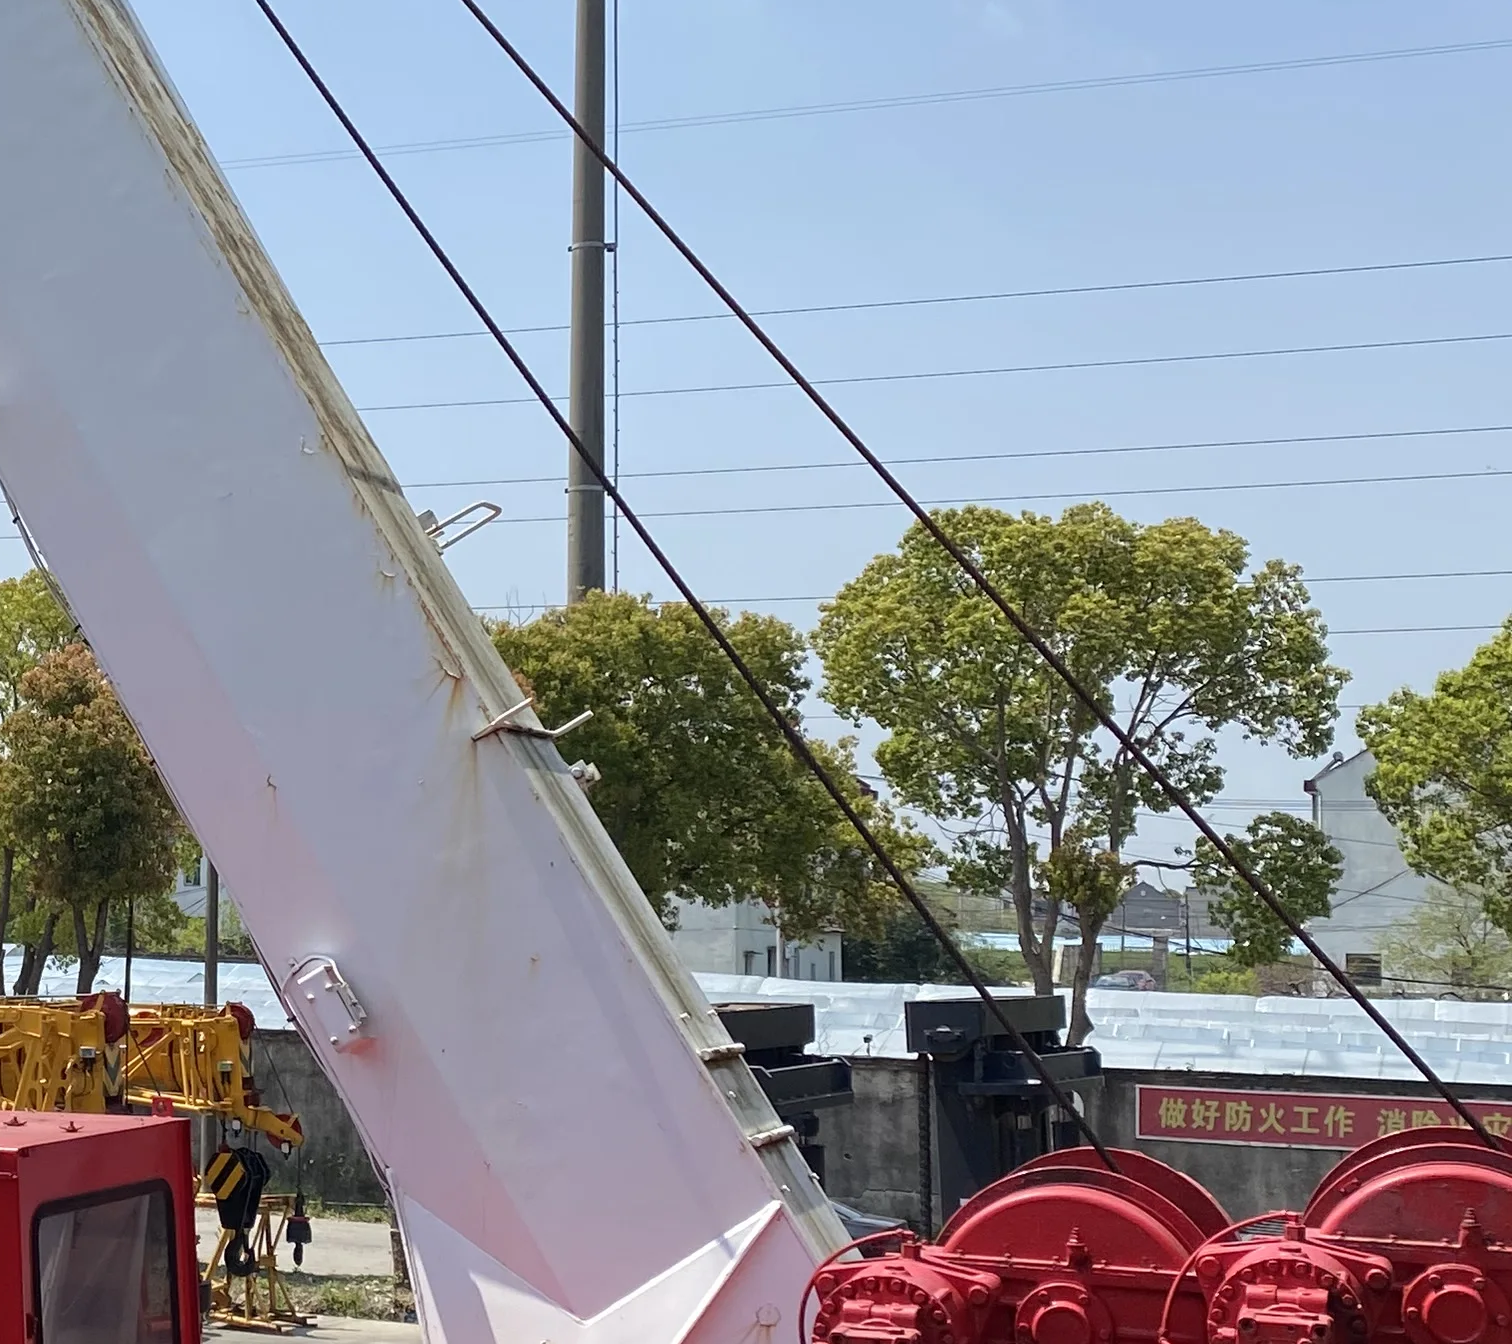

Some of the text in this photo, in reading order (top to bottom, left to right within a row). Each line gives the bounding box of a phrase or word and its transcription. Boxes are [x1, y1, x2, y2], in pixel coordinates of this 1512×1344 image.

[1158, 1097, 1356, 1139] 做好防火工作
